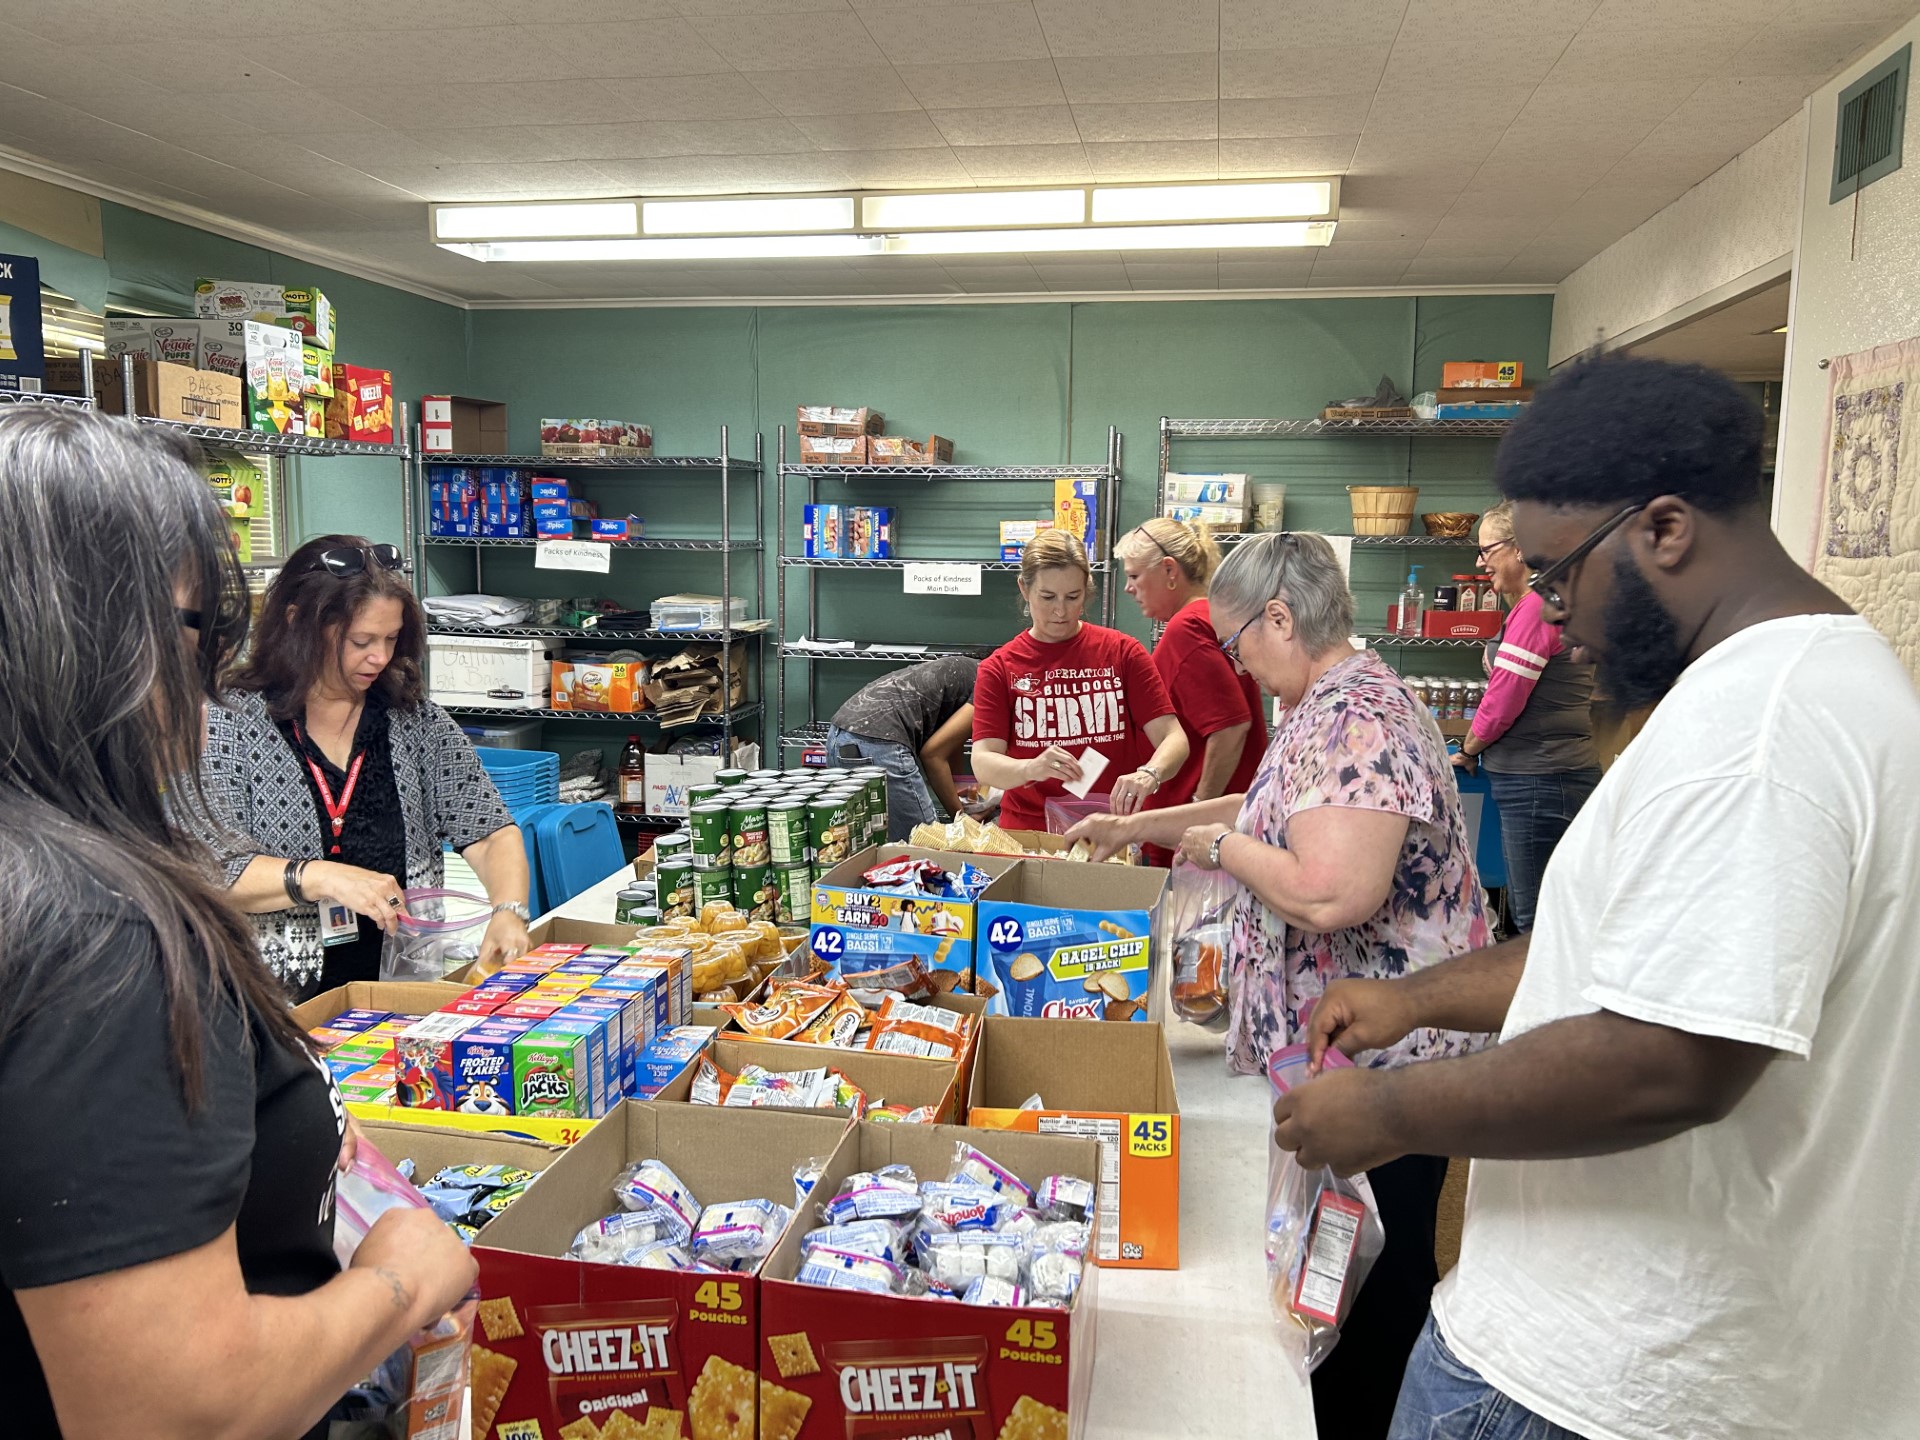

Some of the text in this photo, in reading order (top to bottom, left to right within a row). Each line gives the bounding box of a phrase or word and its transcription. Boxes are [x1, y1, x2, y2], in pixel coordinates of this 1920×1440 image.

[228, 322, 243, 332] 30
[289, 332, 300, 345] 30
[156, 338, 195, 354] Veggie
[164, 351, 190, 360] PUFFS
[204, 351, 240, 369] Veggie
[1499, 366, 1515, 375] 45
[187, 376, 223, 396] BAGS
[472, 505, 480, 536] Ziploc
[547, 522, 565, 530] Ziploc
[600, 522, 618, 530] Ziploc
[544, 547, 604, 559] Packs of Kindness
[913, 574, 972, 583] Packs of Kindness
[614, 665, 625, 673] 36
[1043, 676, 1122, 696] BULLDOGS
[1014, 689, 1126, 739] SERVE
[1015, 740, 1040, 748] SERVING
[1040, 740, 1053, 748] THE
[1053, 737, 1093, 747] COMMUNITY
[1094, 734, 1112, 743] SINCE
[845, 892, 880, 907] BUY 2
[837, 909, 870, 924] EARN
[871, 913, 889, 927] 20
[1026, 917, 1060, 928] SINGLE SERVE
[845, 932, 879, 941] SINGLE SERVE
[990, 920, 1022, 945] 42
[1027, 923, 1061, 938] BAGS!
[813, 931, 842, 953] 42
[846, 940, 879, 951] BAGS!
[1060, 941, 1144, 966] BAGEL CHIP
[1096, 959, 1121, 972] BACK!
[1068, 997, 1090, 1006] SAVORY
[1040, 997, 1103, 1020] Chex
[467, 1045, 495, 1057] Kellogg's
[459, 1056, 505, 1069] FROSTED
[528, 1052, 559, 1065] Kellogg's
[462, 1065, 502, 1076] FLAKES
[528, 1073, 558, 1082] APPLE
[521, 1080, 569, 1108] JACKS
[560, 1128, 582, 1146] 36
[1133, 1120, 1168, 1142] 45
[1133, 1142, 1167, 1152] PACKS
[1341, 1231, 1353, 1241] 100
[694, 1280, 743, 1311] 45
[689, 1309, 748, 1326] Pouches
[1005, 1318, 1057, 1350] 45
[1000, 1347, 1062, 1365] Pouches
[576, 1372, 649, 1382] baked snack crackers
[875, 1411, 954, 1422] baked snack crackers
